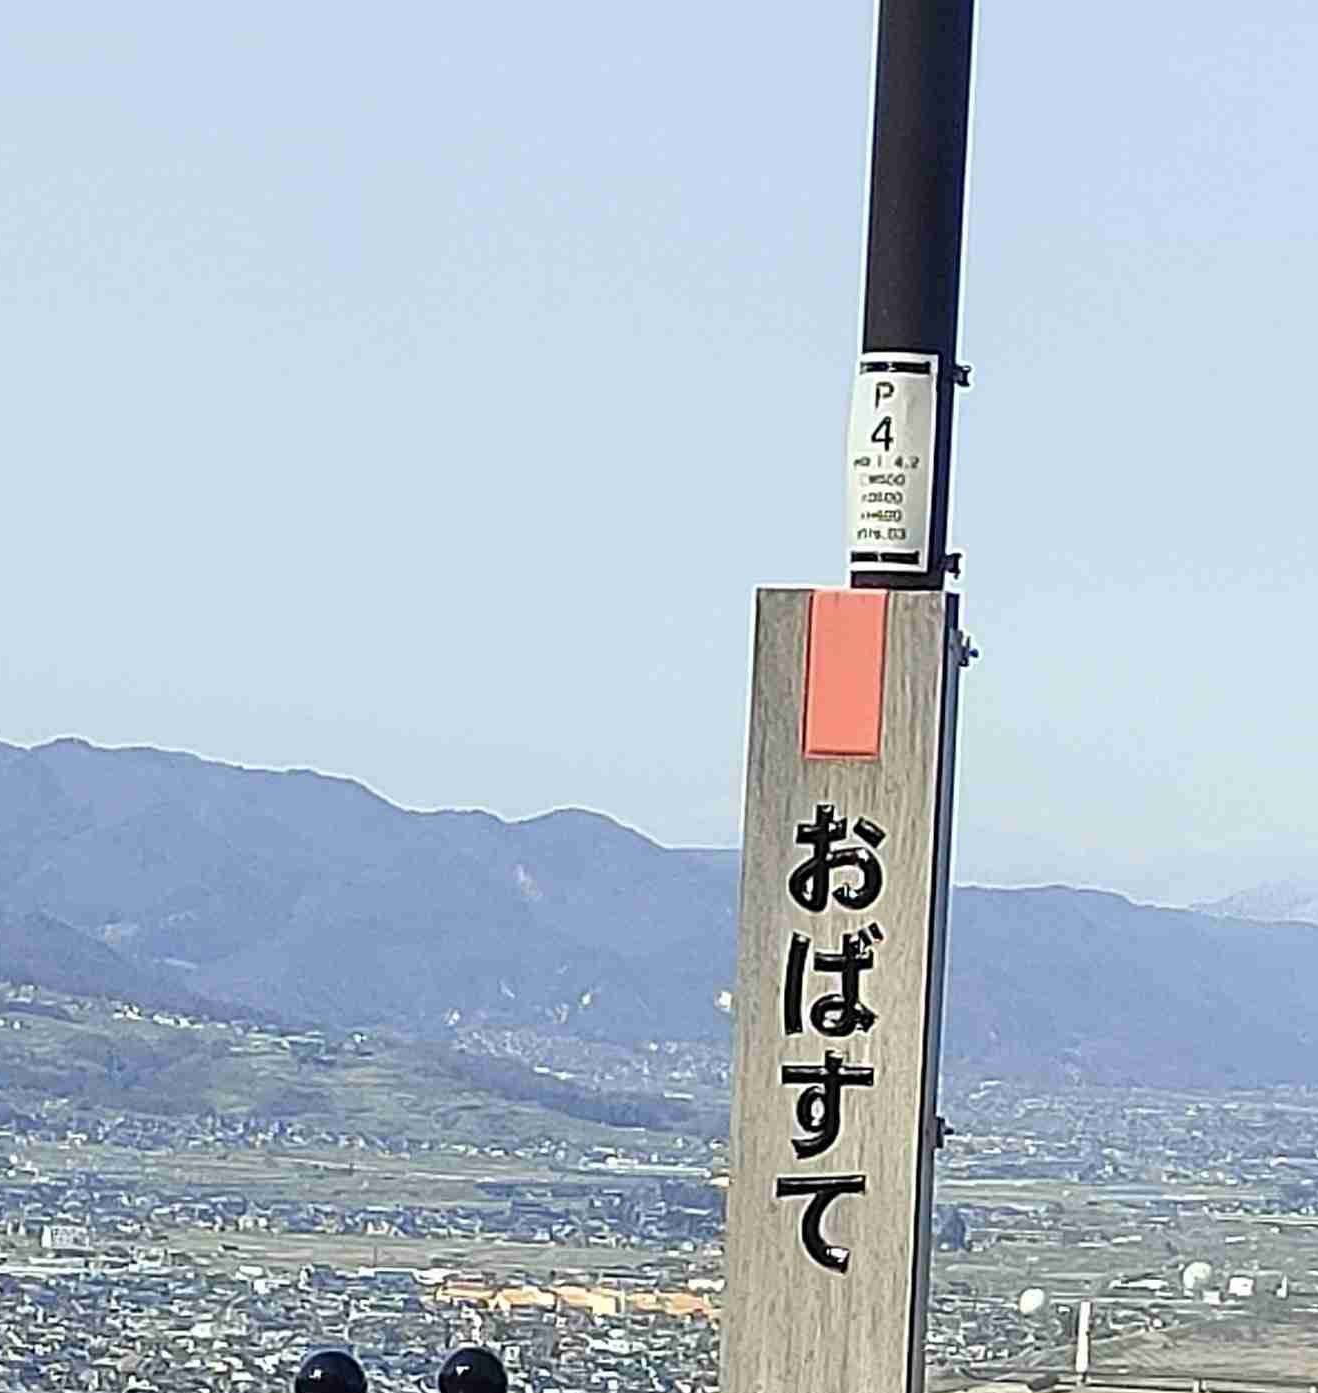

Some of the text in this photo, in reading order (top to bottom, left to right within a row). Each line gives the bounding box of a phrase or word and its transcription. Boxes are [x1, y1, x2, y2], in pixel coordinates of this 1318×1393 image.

[874, 381, 895, 409] P
[870, 415, 894, 452] 4
[775, 803, 887, 1274] おばすて
